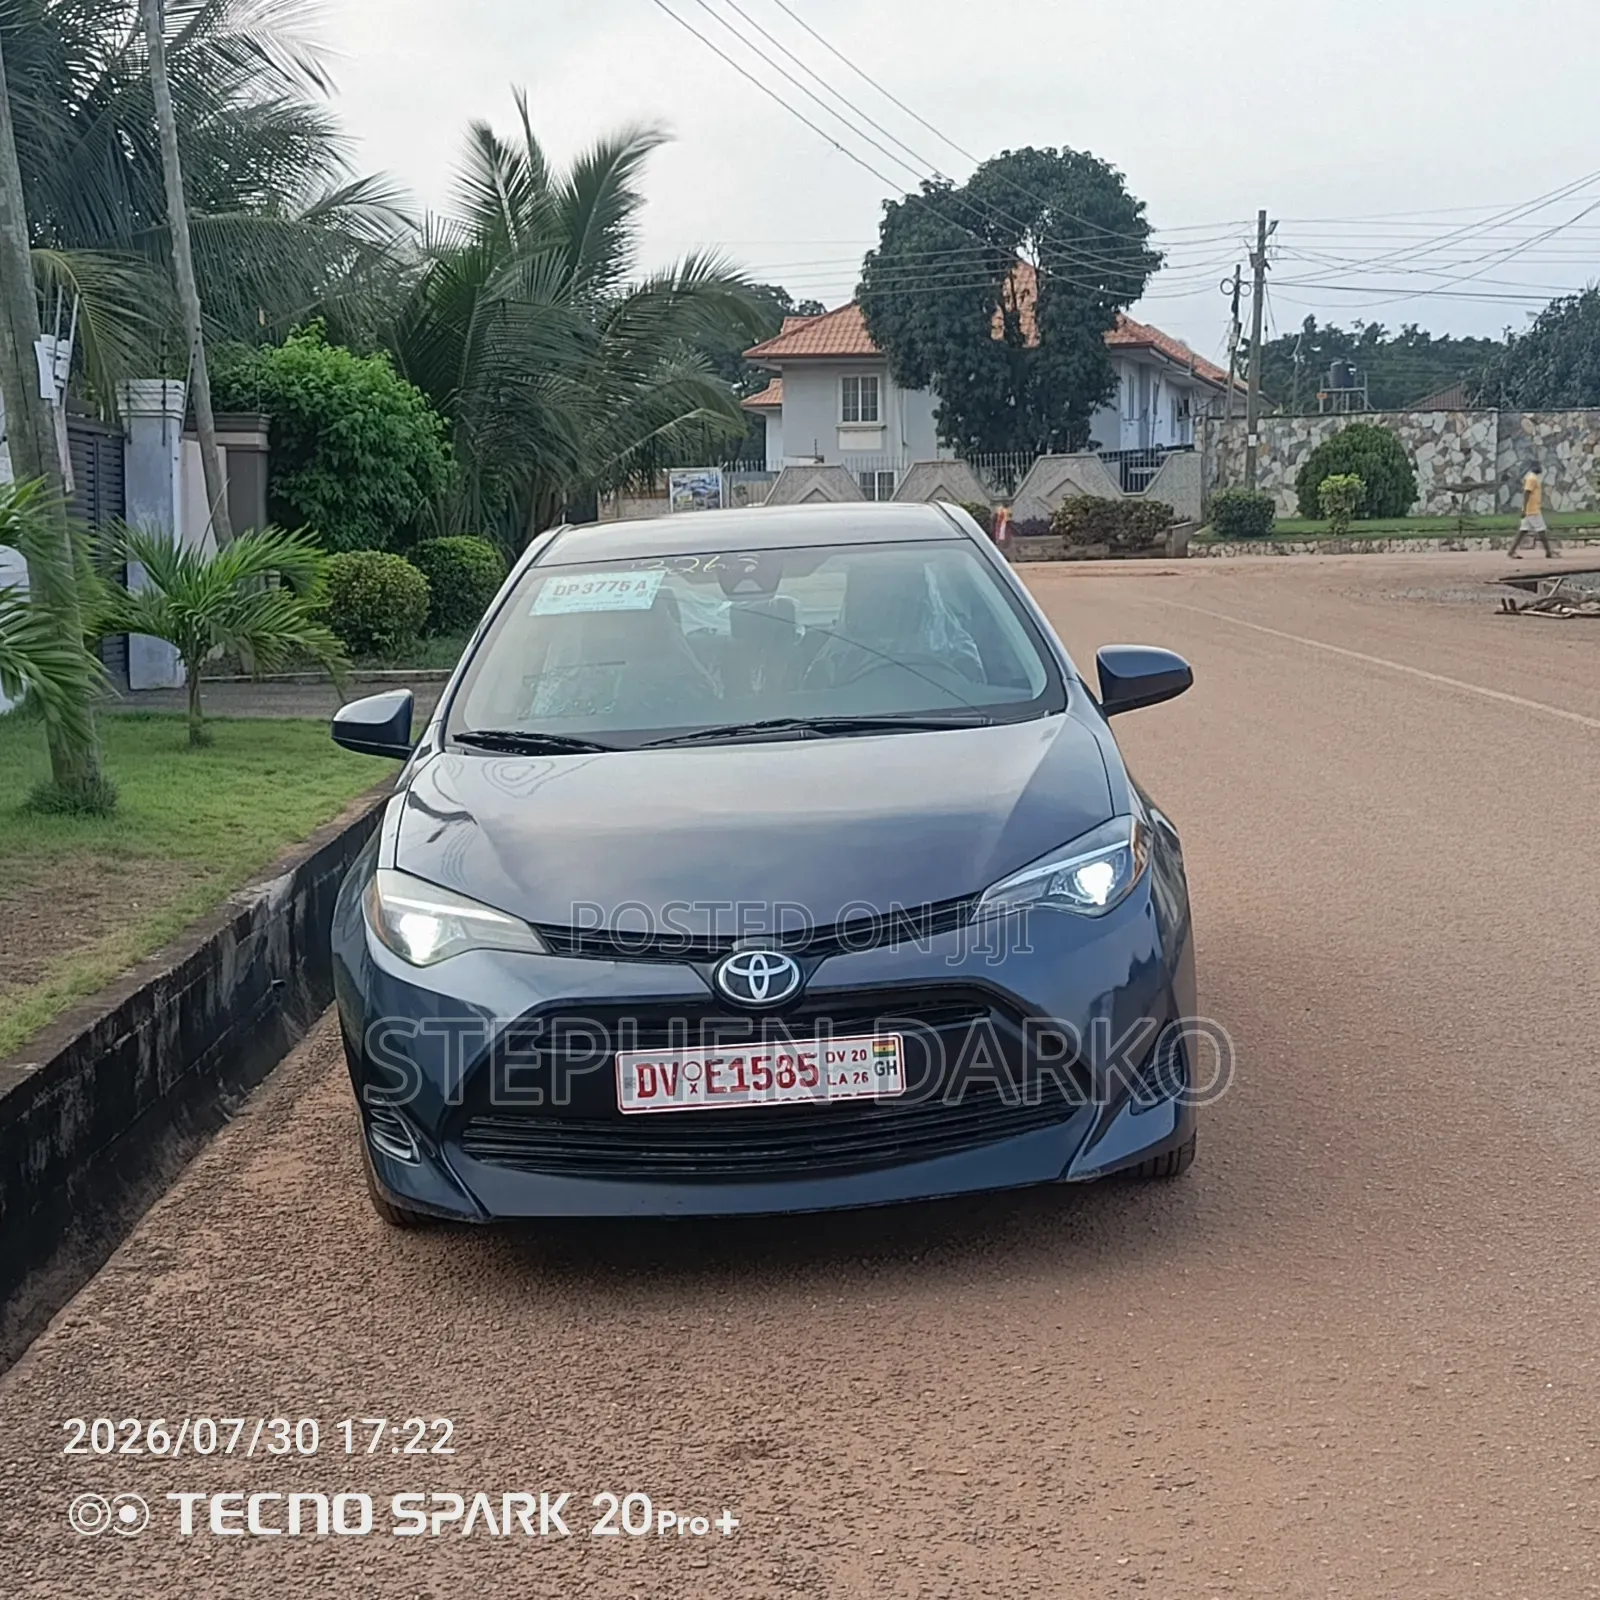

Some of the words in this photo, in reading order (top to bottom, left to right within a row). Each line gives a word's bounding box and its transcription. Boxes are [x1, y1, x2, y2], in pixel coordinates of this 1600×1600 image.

[552, 583, 580, 597] DP
[633, 579, 648, 592] A
[825, 1050, 846, 1064] DV
[851, 1049, 868, 1062] 20
[874, 1060, 898, 1077] GH
[635, 1061, 679, 1099] DV
[827, 1072, 848, 1086] LA
[853, 1071, 869, 1085] 26
